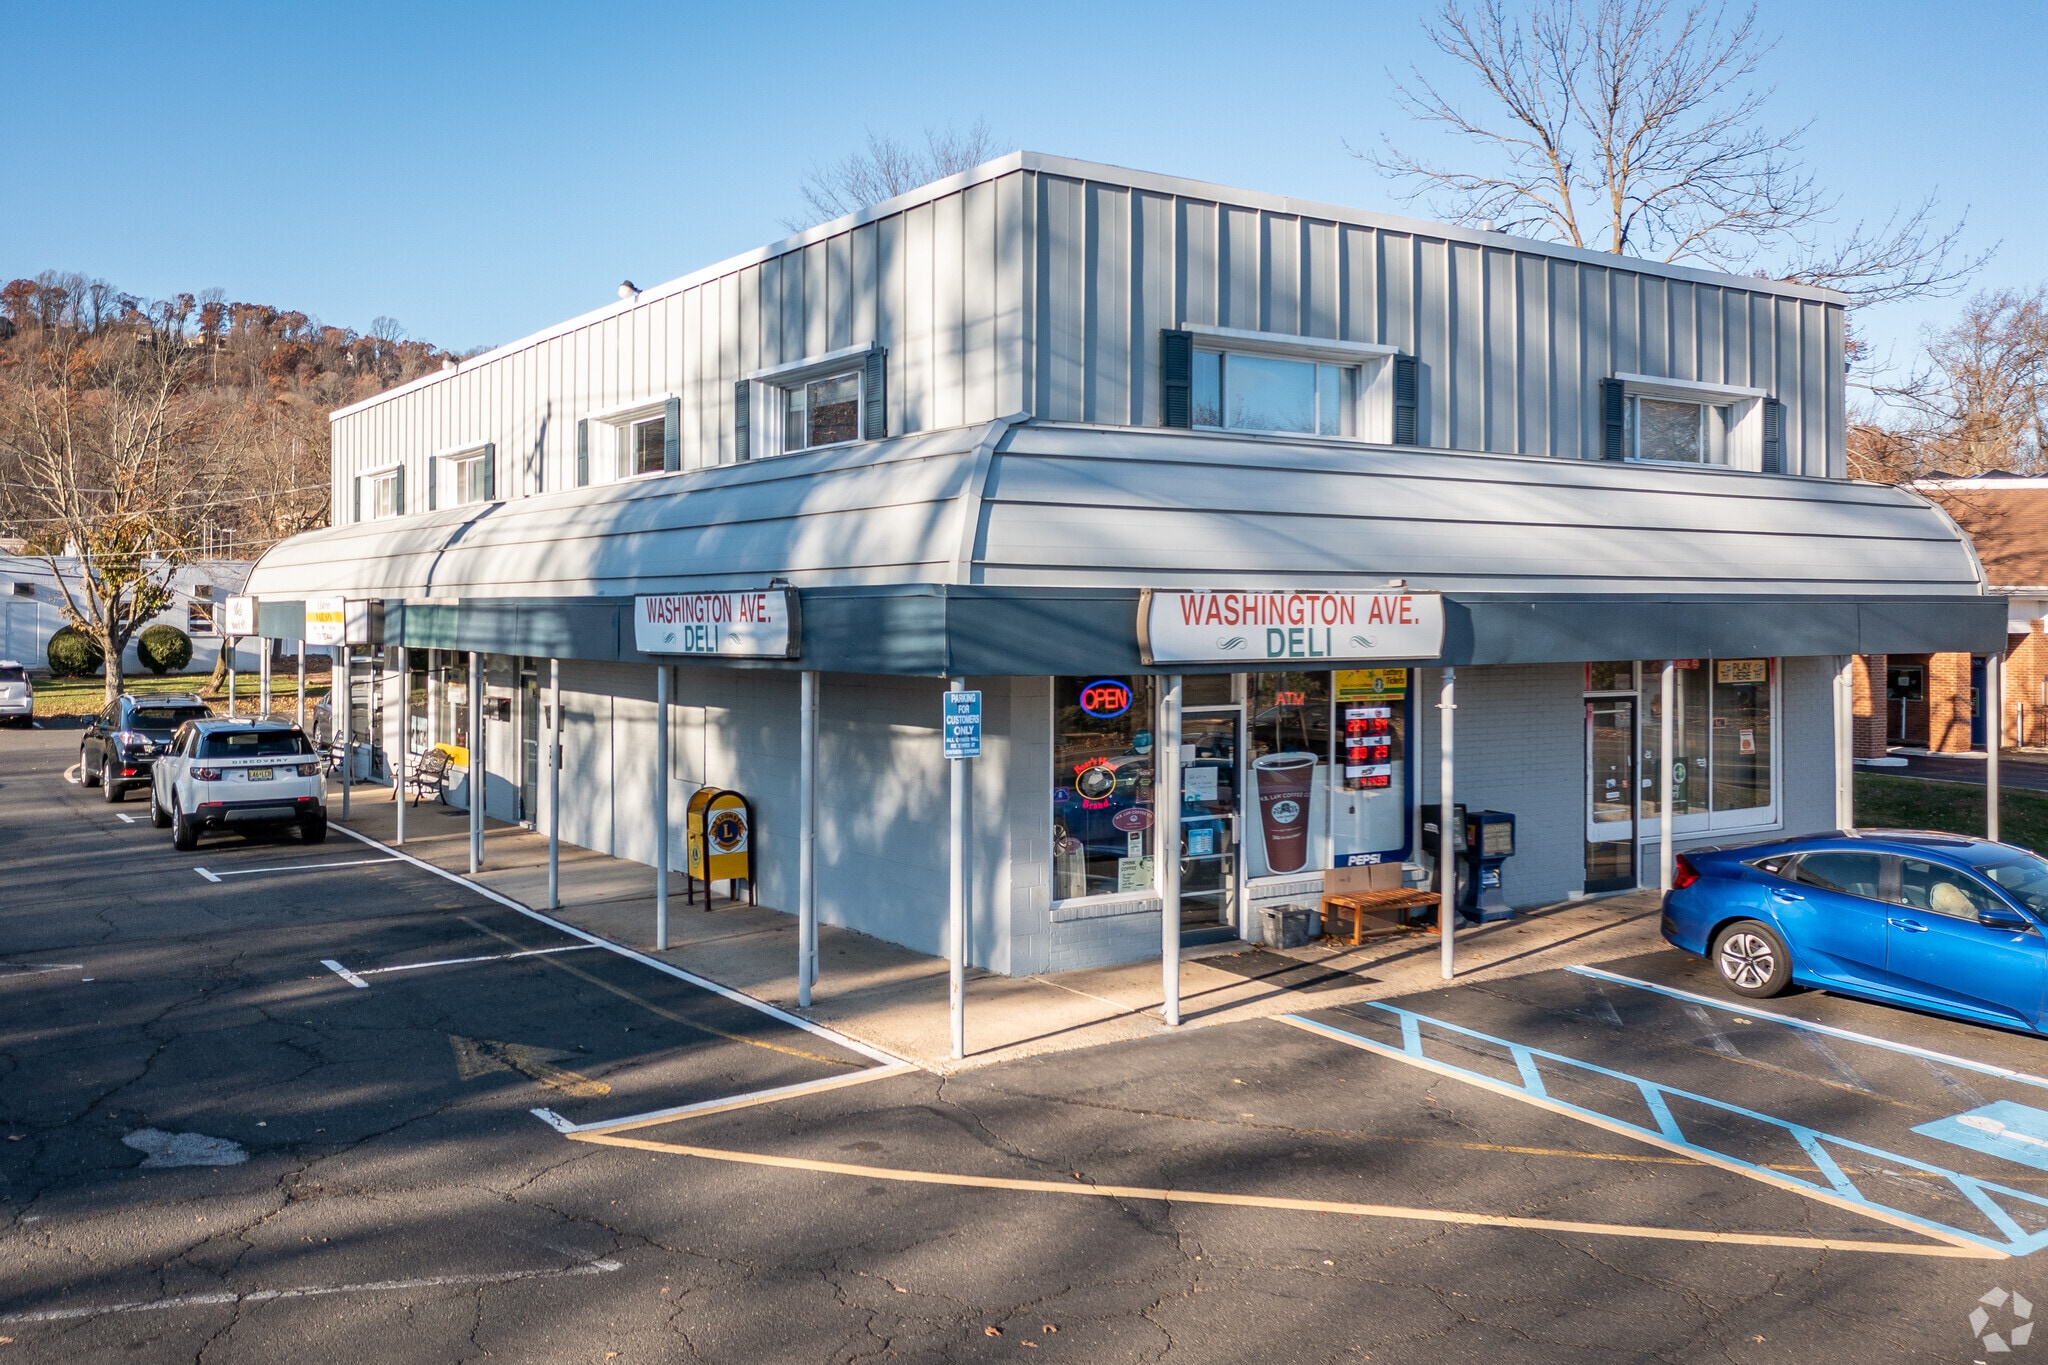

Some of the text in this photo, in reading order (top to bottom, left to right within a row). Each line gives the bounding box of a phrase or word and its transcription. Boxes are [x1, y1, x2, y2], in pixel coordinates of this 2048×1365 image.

[646, 594, 771, 624] WASHINGTON AVE.
[1179, 594, 1420, 626] WASHINGTON AVE.
[684, 625, 719, 653] DELI
[1266, 627, 1332, 658] DELI
[1732, 662, 1752, 672] PLAY
[1385, 677, 1405, 685] Tickets
[1732, 672, 1751, 680] HERE
[950, 693, 976, 703] PARKING
[1081, 688, 1127, 710] OPEN
[1275, 691, 1305, 706] ATM
[957, 704, 970, 714] FOR
[946, 714, 980, 725] CUSTOMERS
[953, 725, 975, 736] ONLY
[1282, 791, 1304, 799] COFFEE
[1082, 798, 1110, 811] Brand
[723, 823, 733, 838] L
[1347, 853, 1382, 866] PEPSI
